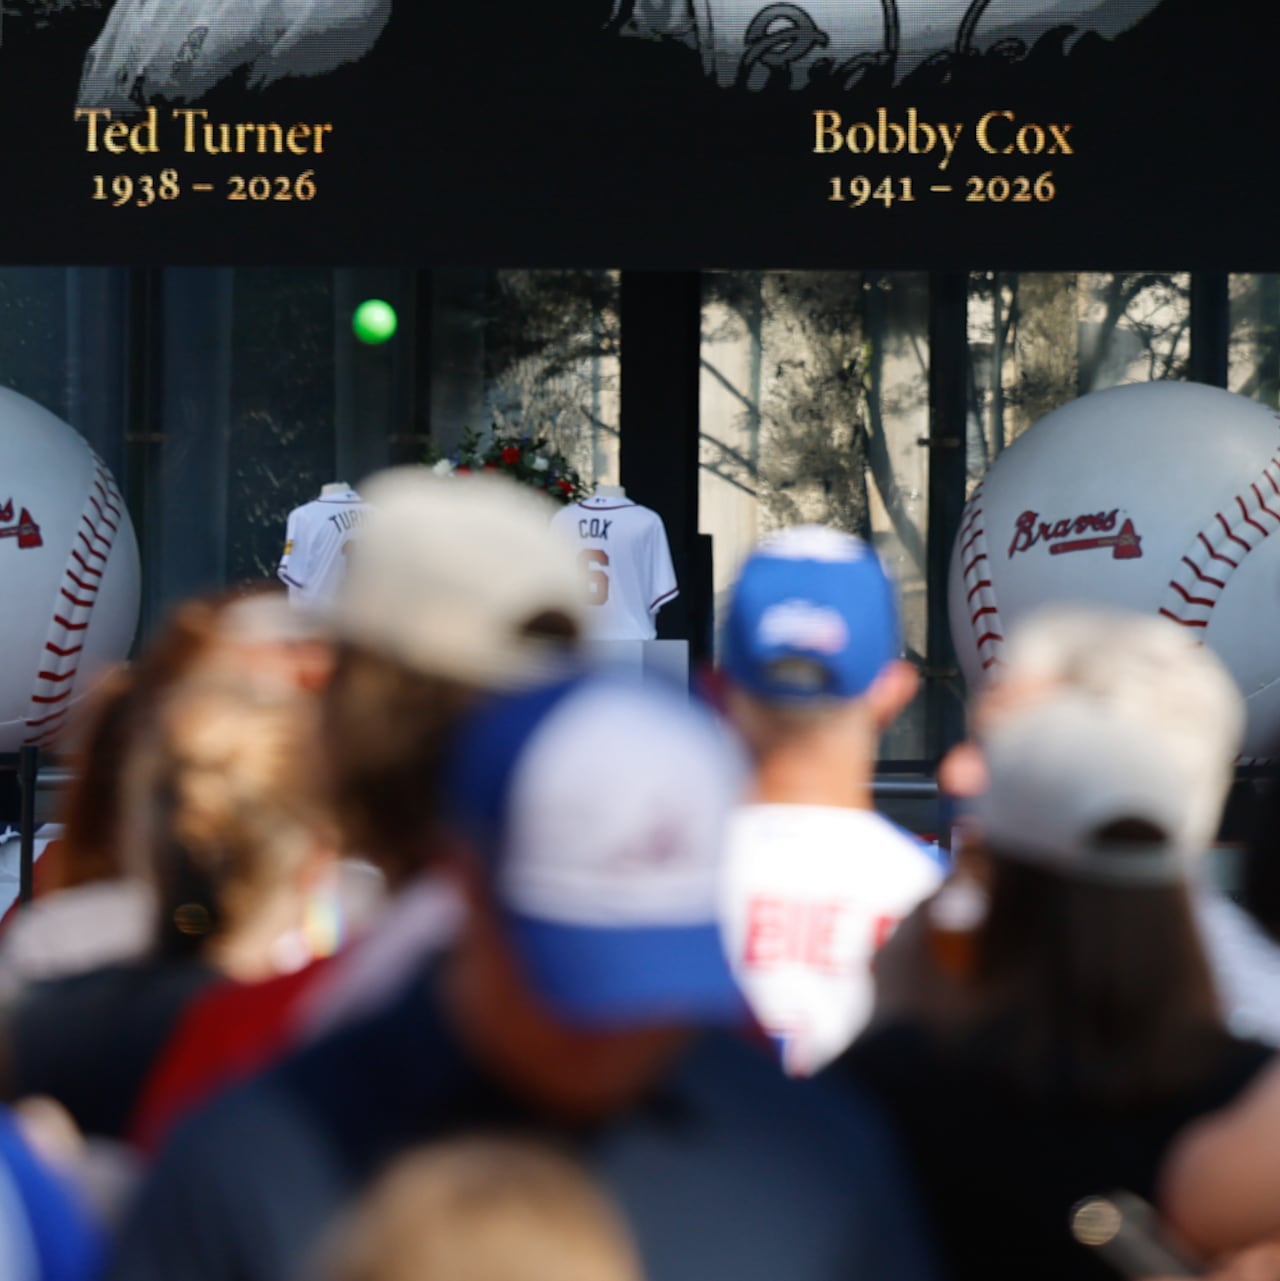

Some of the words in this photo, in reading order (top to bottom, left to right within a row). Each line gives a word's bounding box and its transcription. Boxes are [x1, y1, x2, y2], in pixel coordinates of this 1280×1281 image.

[74, 105, 160, 155] Ted
[172, 107, 333, 155] Turner
[812, 107, 964, 171] Bobby
[976, 109, 1074, 155] Cox
[91, 168, 181, 208] 1938
[226, 169, 318, 202] 2026
[827, 175, 917, 209] 1941
[965, 171, 1057, 203] 2026
[578, 517, 614, 541] COX
[1007, 508, 1120, 560] Braves
[575, 548, 610, 607] 6
